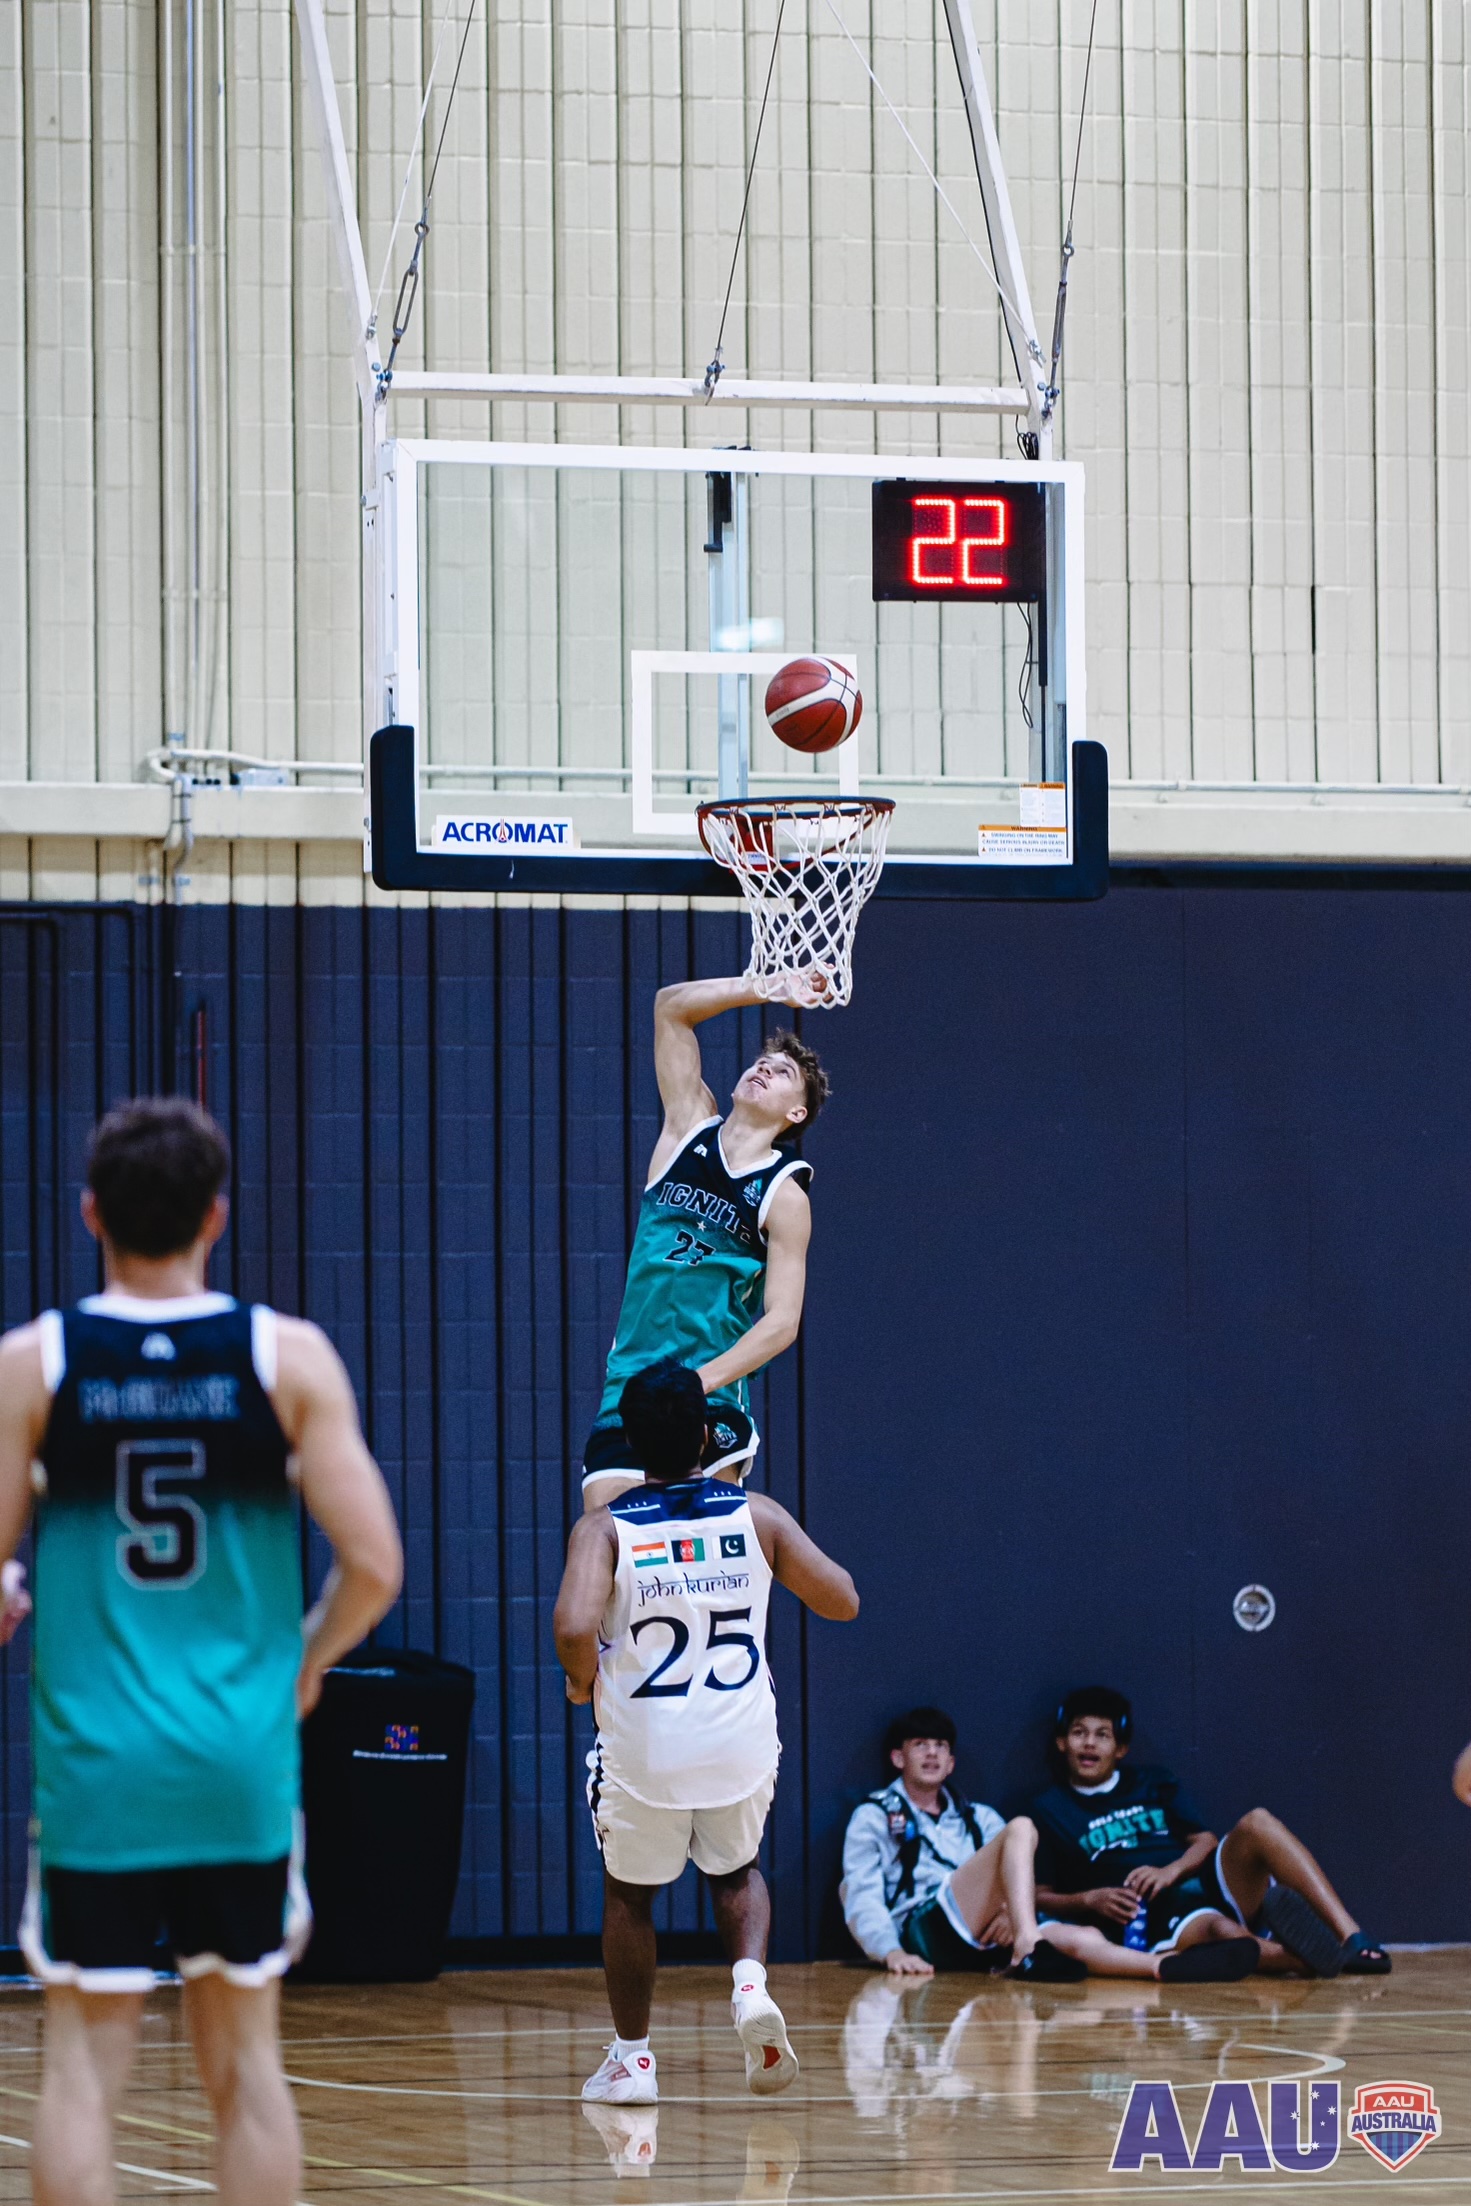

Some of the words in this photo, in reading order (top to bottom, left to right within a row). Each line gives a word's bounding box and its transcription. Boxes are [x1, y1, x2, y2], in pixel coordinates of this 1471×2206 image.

[913, 498, 1005, 585] 22
[442, 819, 568, 843] ACROMAT
[663, 1229, 716, 1266] 27
[116, 1439, 207, 1591] 5
[638, 1576, 683, 1607] john
[683, 1570, 749, 1595] kurian
[629, 1606, 760, 1698] 25
